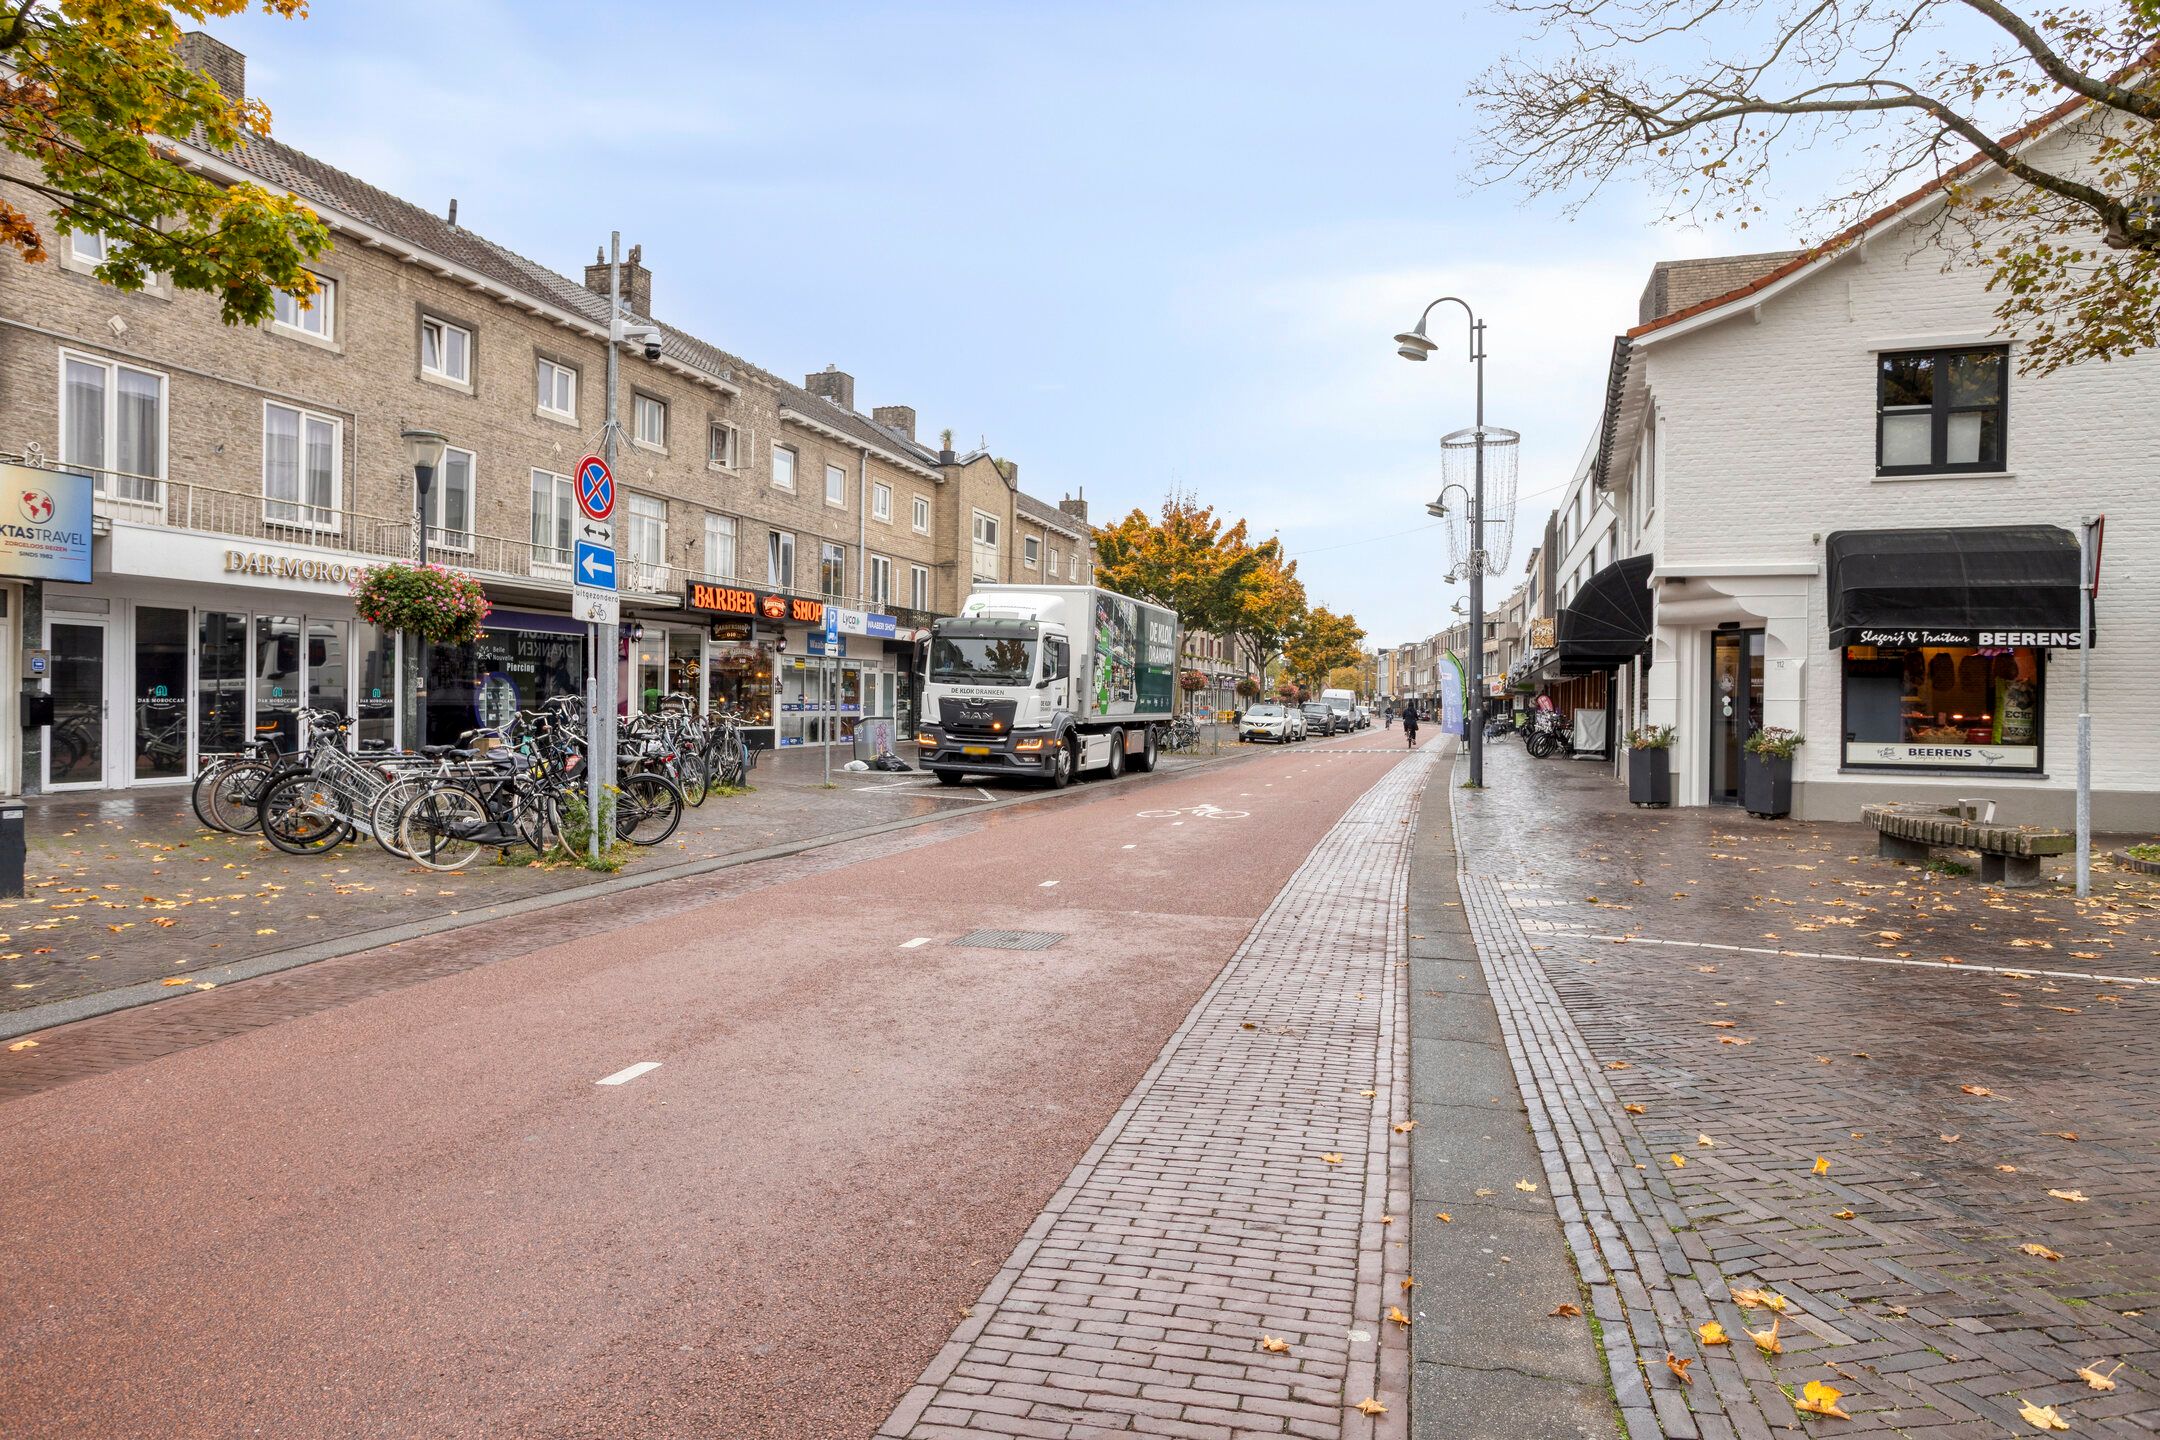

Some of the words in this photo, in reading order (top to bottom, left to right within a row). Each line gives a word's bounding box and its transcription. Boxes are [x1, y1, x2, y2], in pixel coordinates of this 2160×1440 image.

[4, 540, 44, 550] ZORGELOOS
[19, 550, 38, 558] SINDS
[226, 550, 277, 576] DAR
[576, 589, 618, 603] uitgezonderd
[694, 584, 756, 614] BARBER
[792, 599, 823, 623] SHOP
[829, 611, 836, 629] P
[884, 623, 896, 632] SHOP
[1150, 621, 1158, 643] DE
[1158, 624, 1173, 646] KLOK
[1860, 630, 1905, 645] Slagerij
[1907, 631, 1919, 643] &
[1922, 631, 1970, 643] Traiteur
[1978, 632, 2081, 646] BEERENS
[1149, 645, 1172, 665] DRANKEN
[506, 662, 535, 673] Piercing
[959, 711, 994, 720] MAN
[1908, 748, 1972, 757] BEERENS
